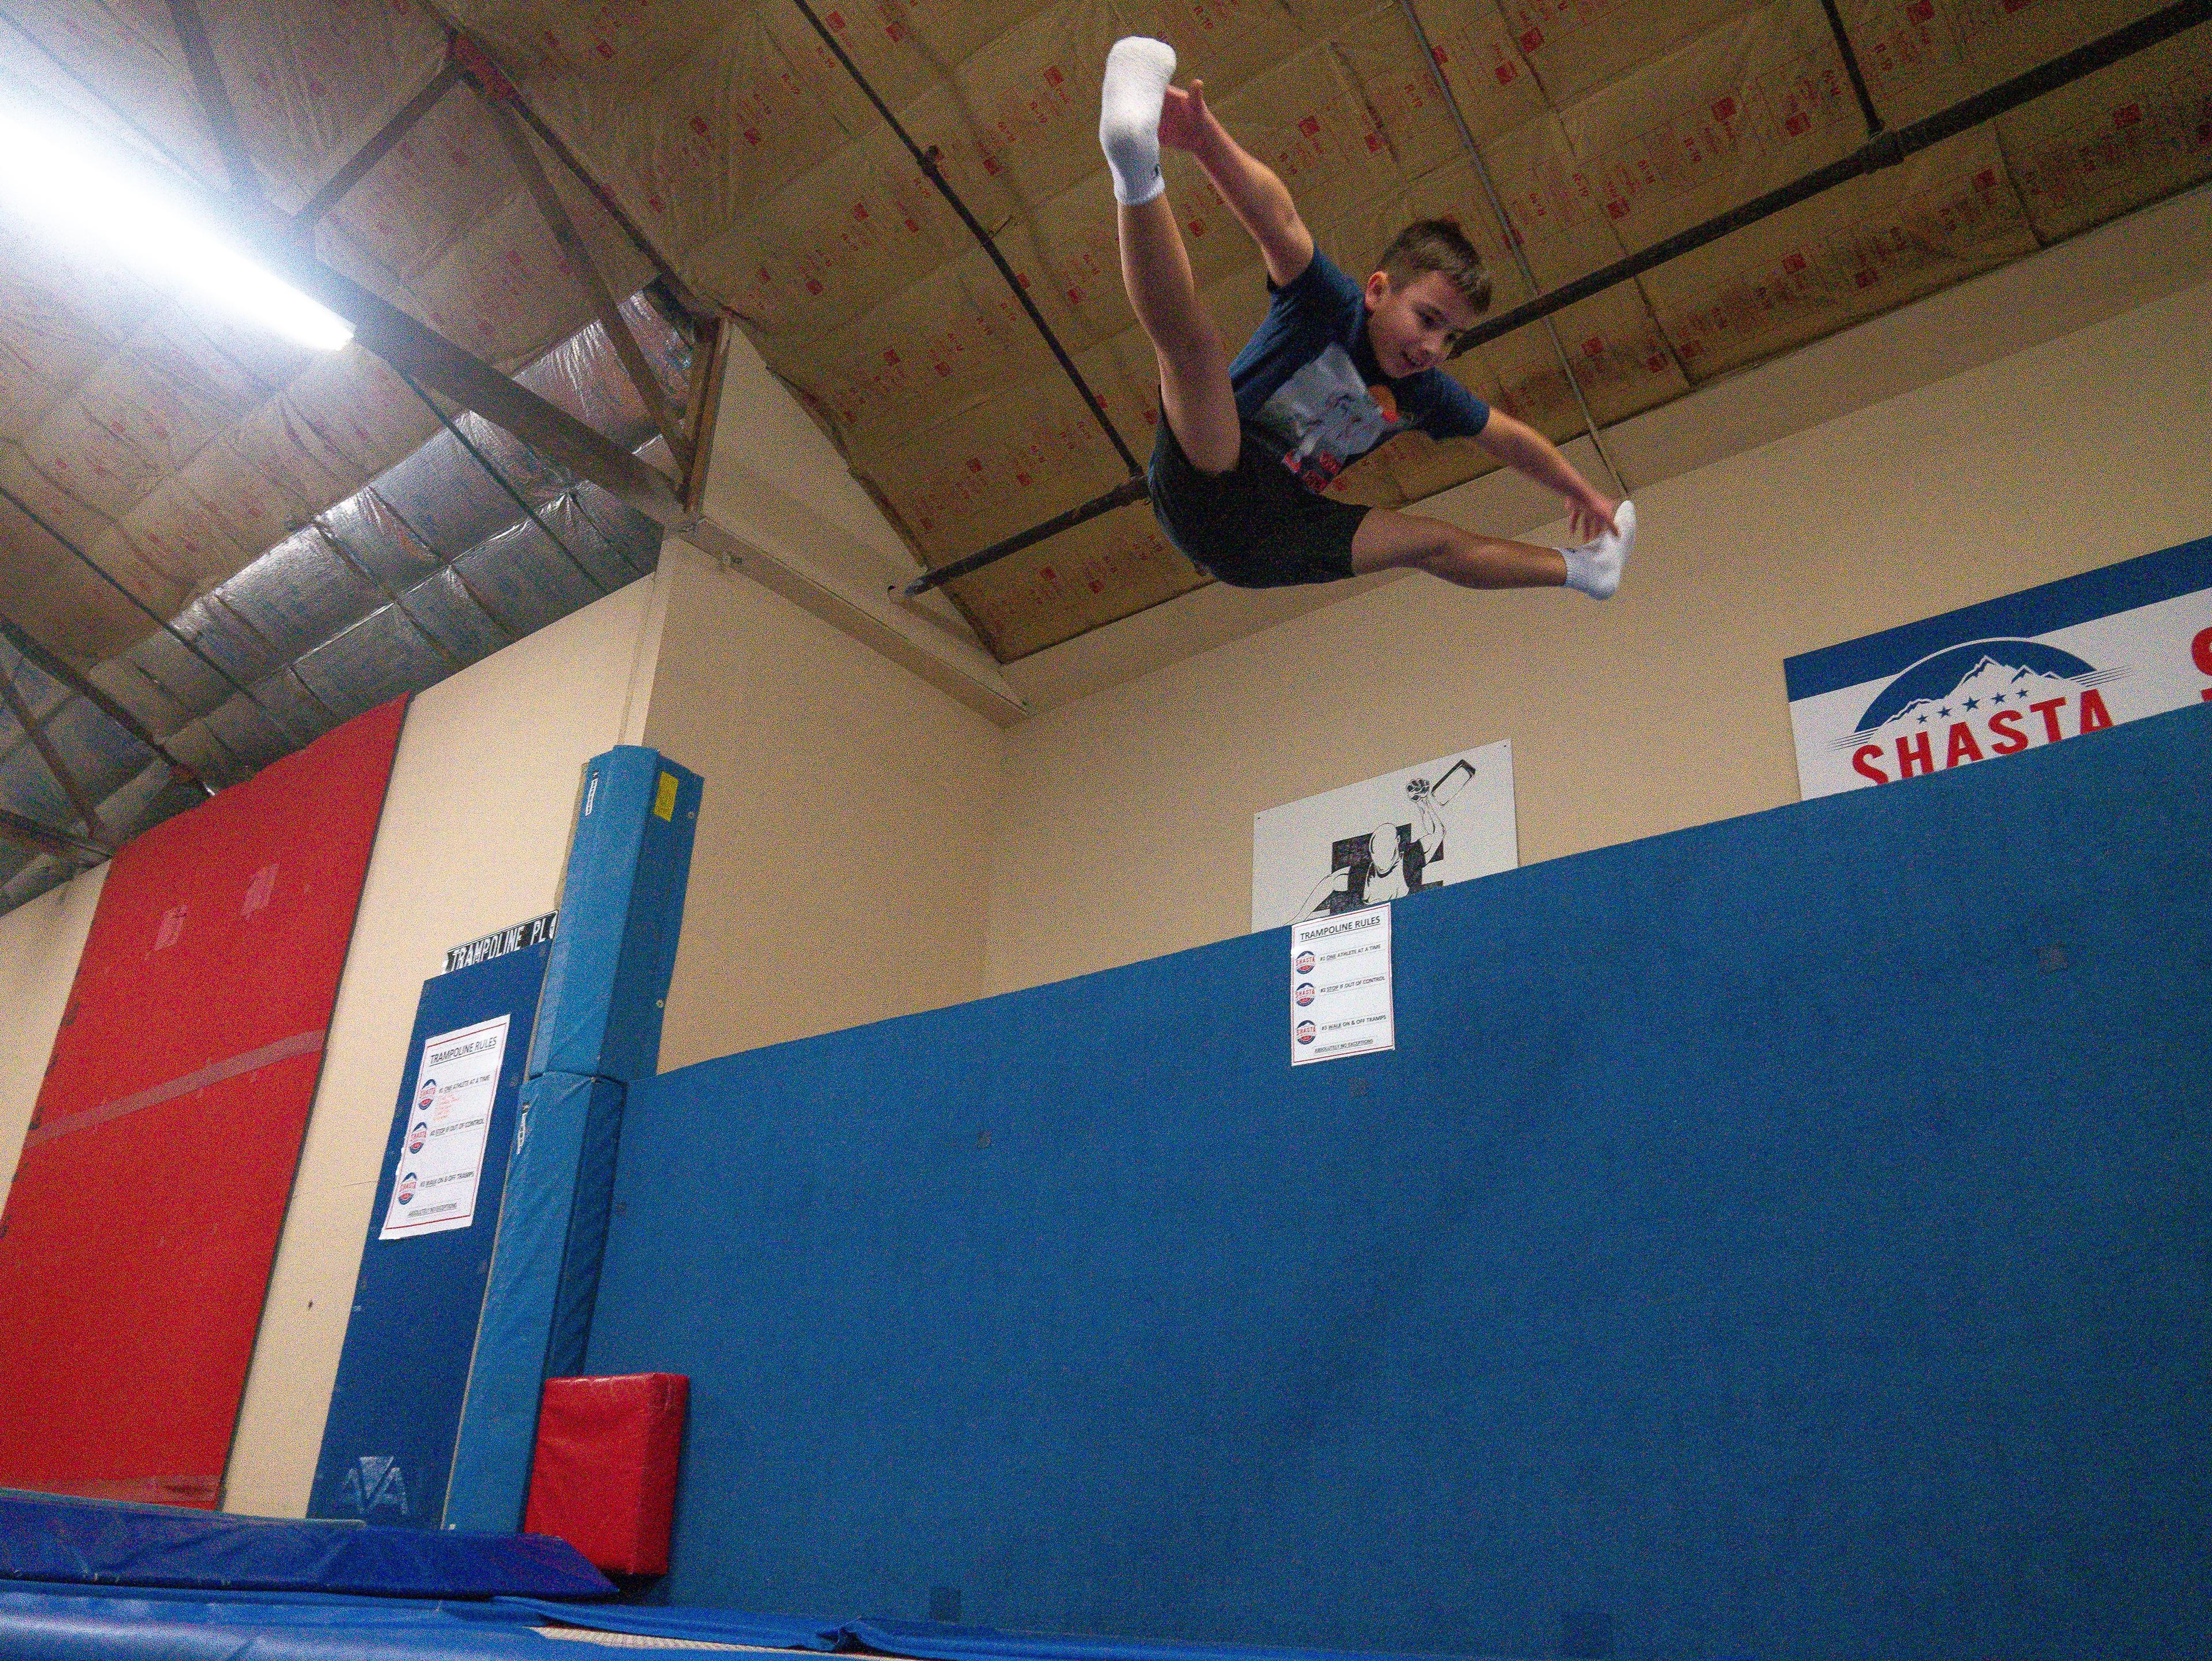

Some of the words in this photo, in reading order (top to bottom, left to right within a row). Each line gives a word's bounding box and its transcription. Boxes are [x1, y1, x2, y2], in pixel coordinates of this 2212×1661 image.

[1851, 688, 2115, 785] SHASTA
[1300, 922, 1353, 940] TRAMPOLINE
[1355, 915, 1380, 928] RULES
[452, 925, 526, 971] TRAMPOLINE
[1362, 976, 1385, 984] CONTROL
[430, 1043, 474, 1064] TRAMPOLINE
[475, 1036, 497, 1051] RULES
